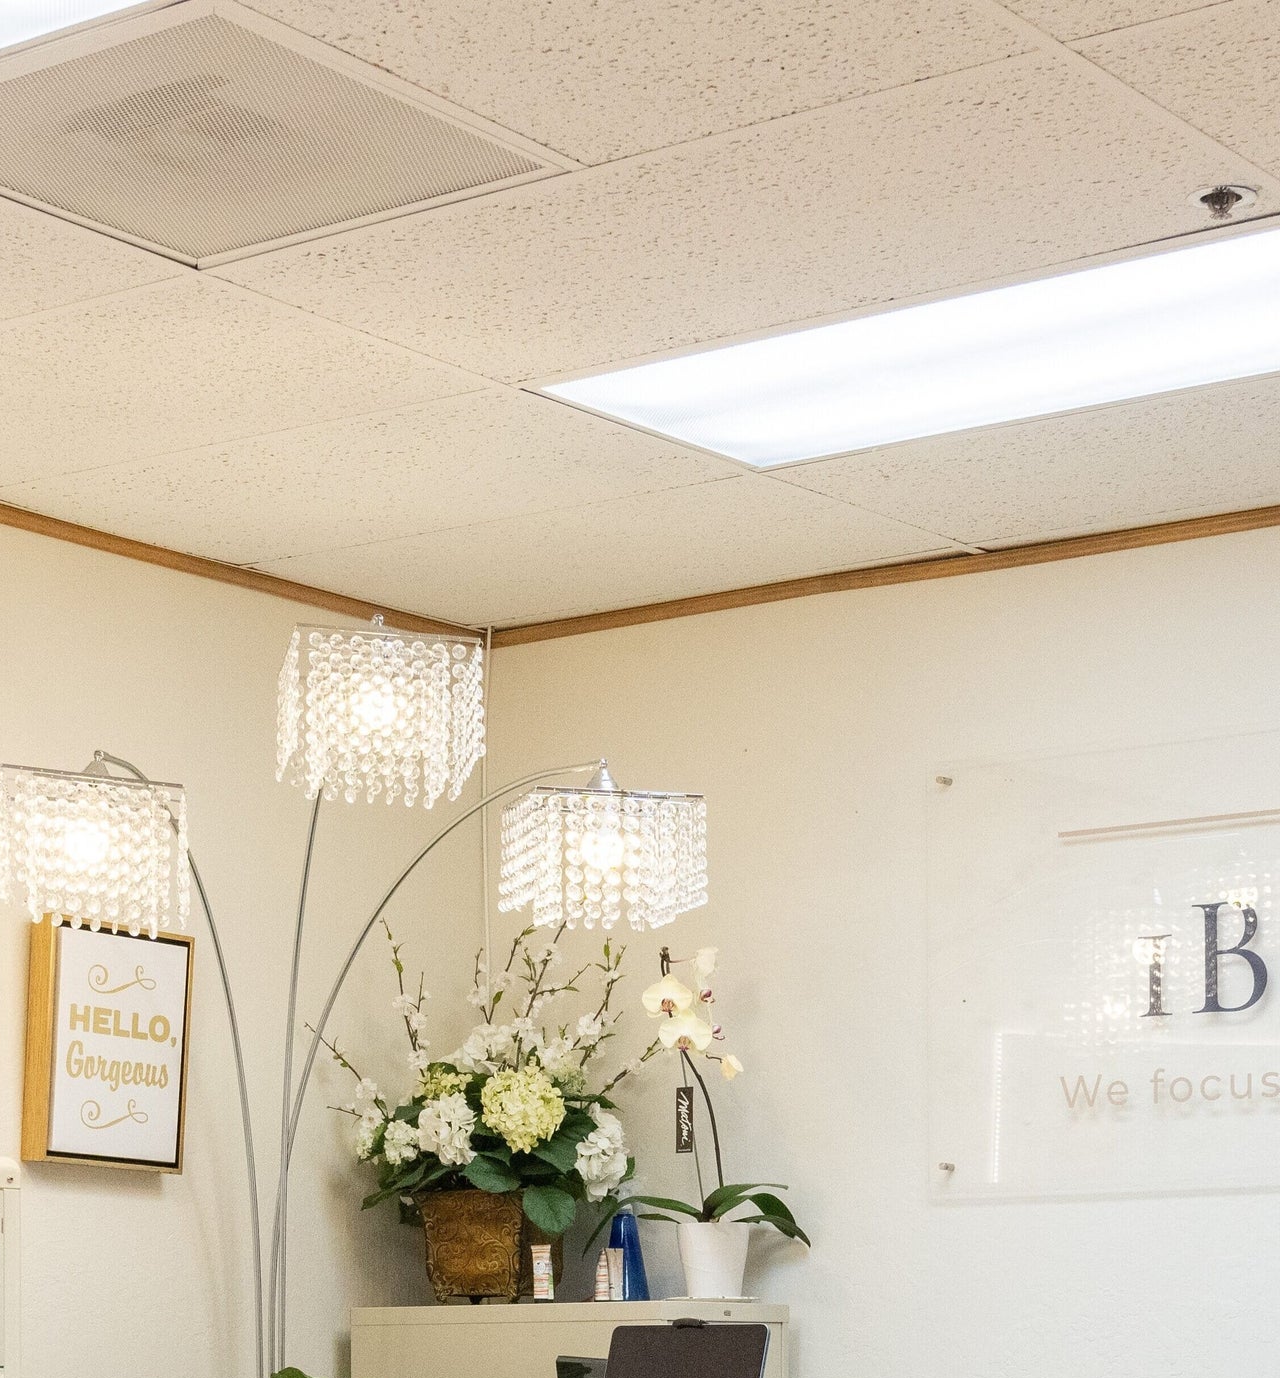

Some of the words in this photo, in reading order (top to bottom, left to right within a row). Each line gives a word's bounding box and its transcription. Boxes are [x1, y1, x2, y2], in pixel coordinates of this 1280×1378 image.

[69, 1003, 177, 1048] HELLO,
[65, 1040, 169, 1092] Gorgeous
[1060, 1073, 1129, 1109] We
[1150, 1068, 1280, 1104] focus
